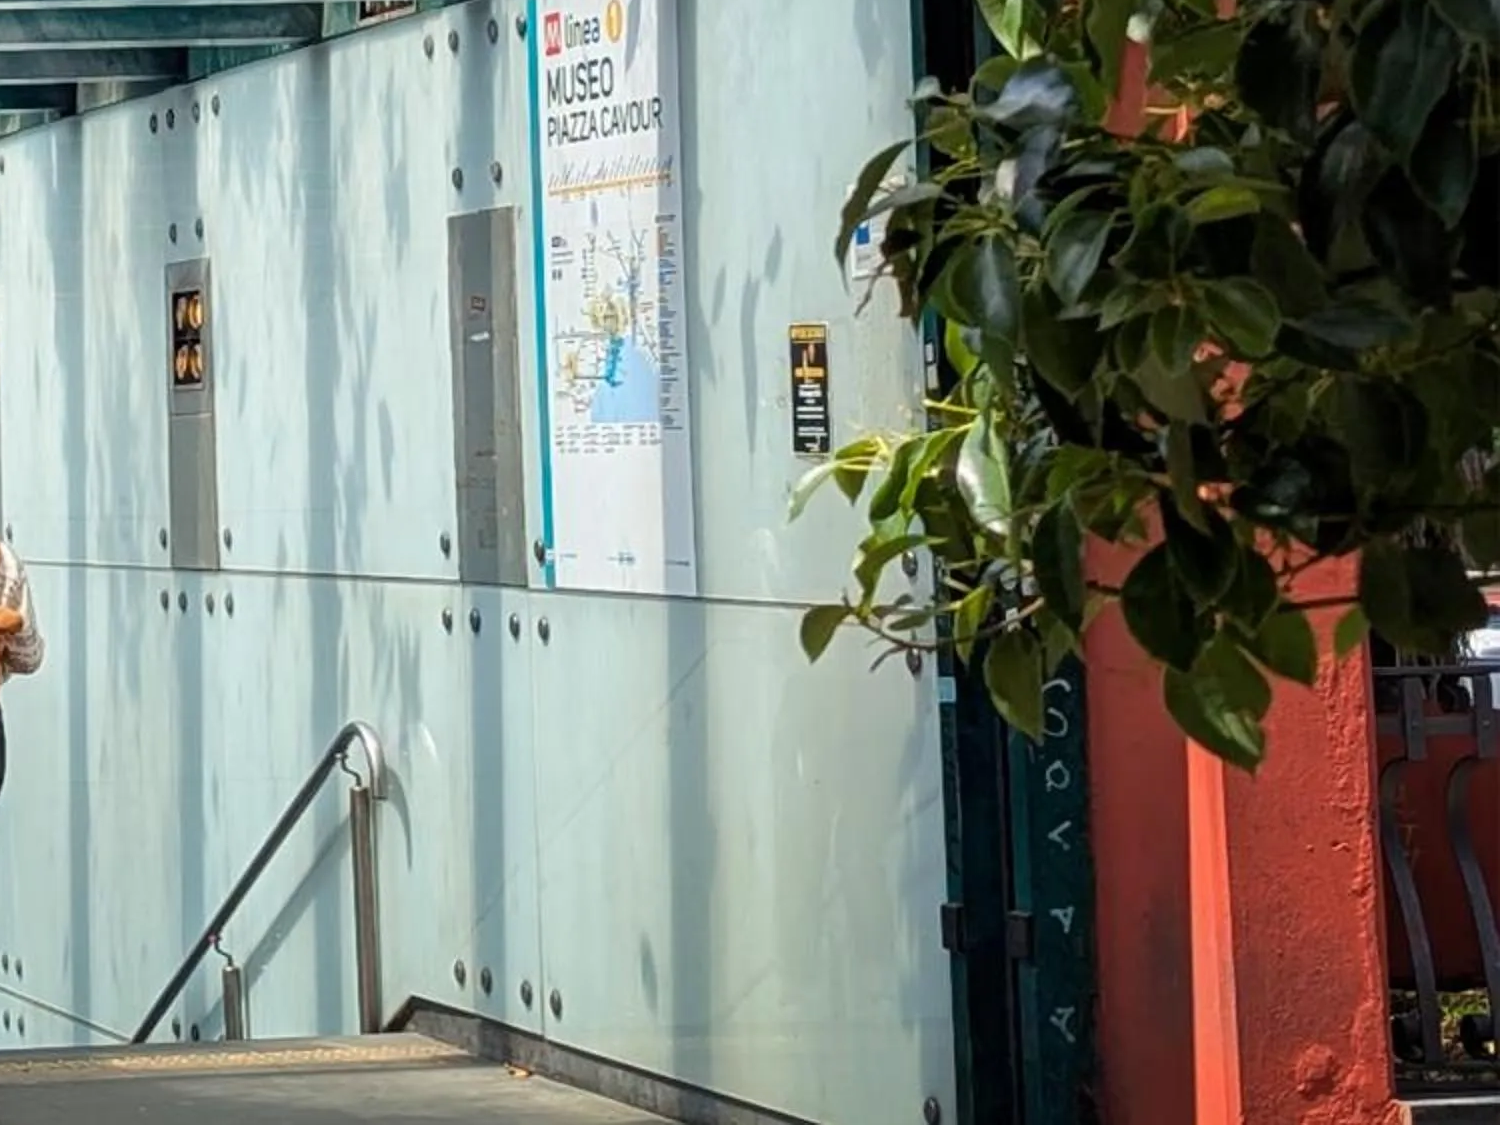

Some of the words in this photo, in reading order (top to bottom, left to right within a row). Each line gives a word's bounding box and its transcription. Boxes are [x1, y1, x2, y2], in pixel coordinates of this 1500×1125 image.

[564, 11, 601, 48] linea
[547, 56, 614, 108] MUSEO
[547, 109, 599, 147] PIAZZA
[600, 97, 663, 137] CAVOUR
